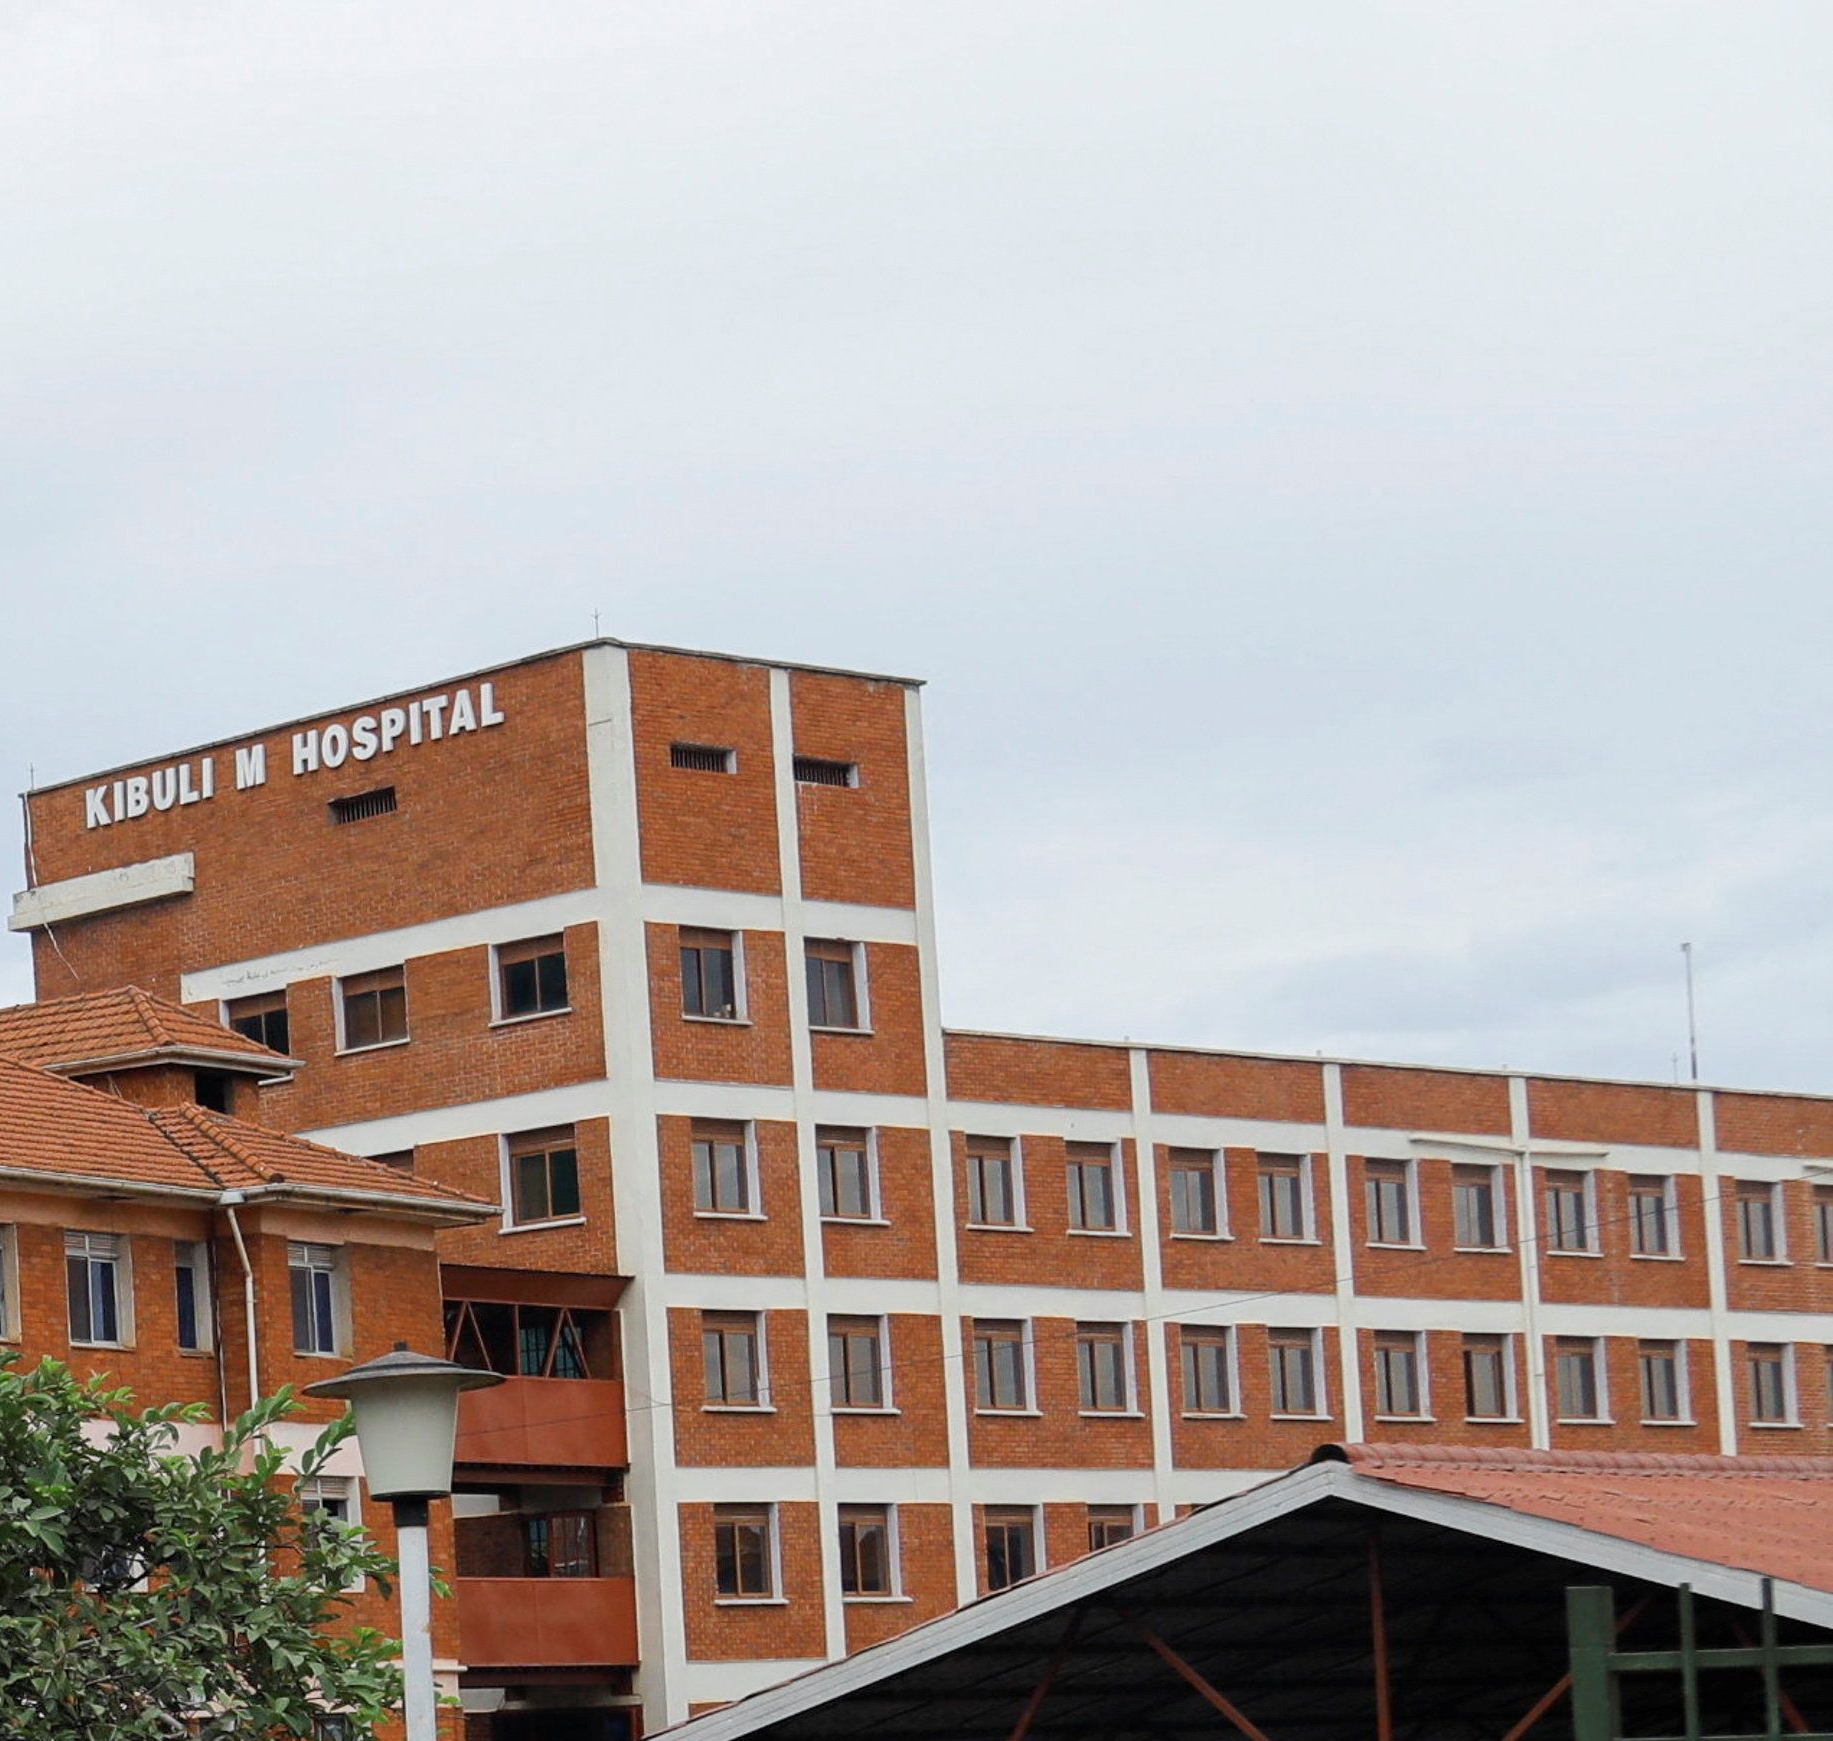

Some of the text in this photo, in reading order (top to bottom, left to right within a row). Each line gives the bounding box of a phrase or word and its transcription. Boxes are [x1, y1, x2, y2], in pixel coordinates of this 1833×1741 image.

[85, 682, 506, 830] KIBULI M HOSPITAL
